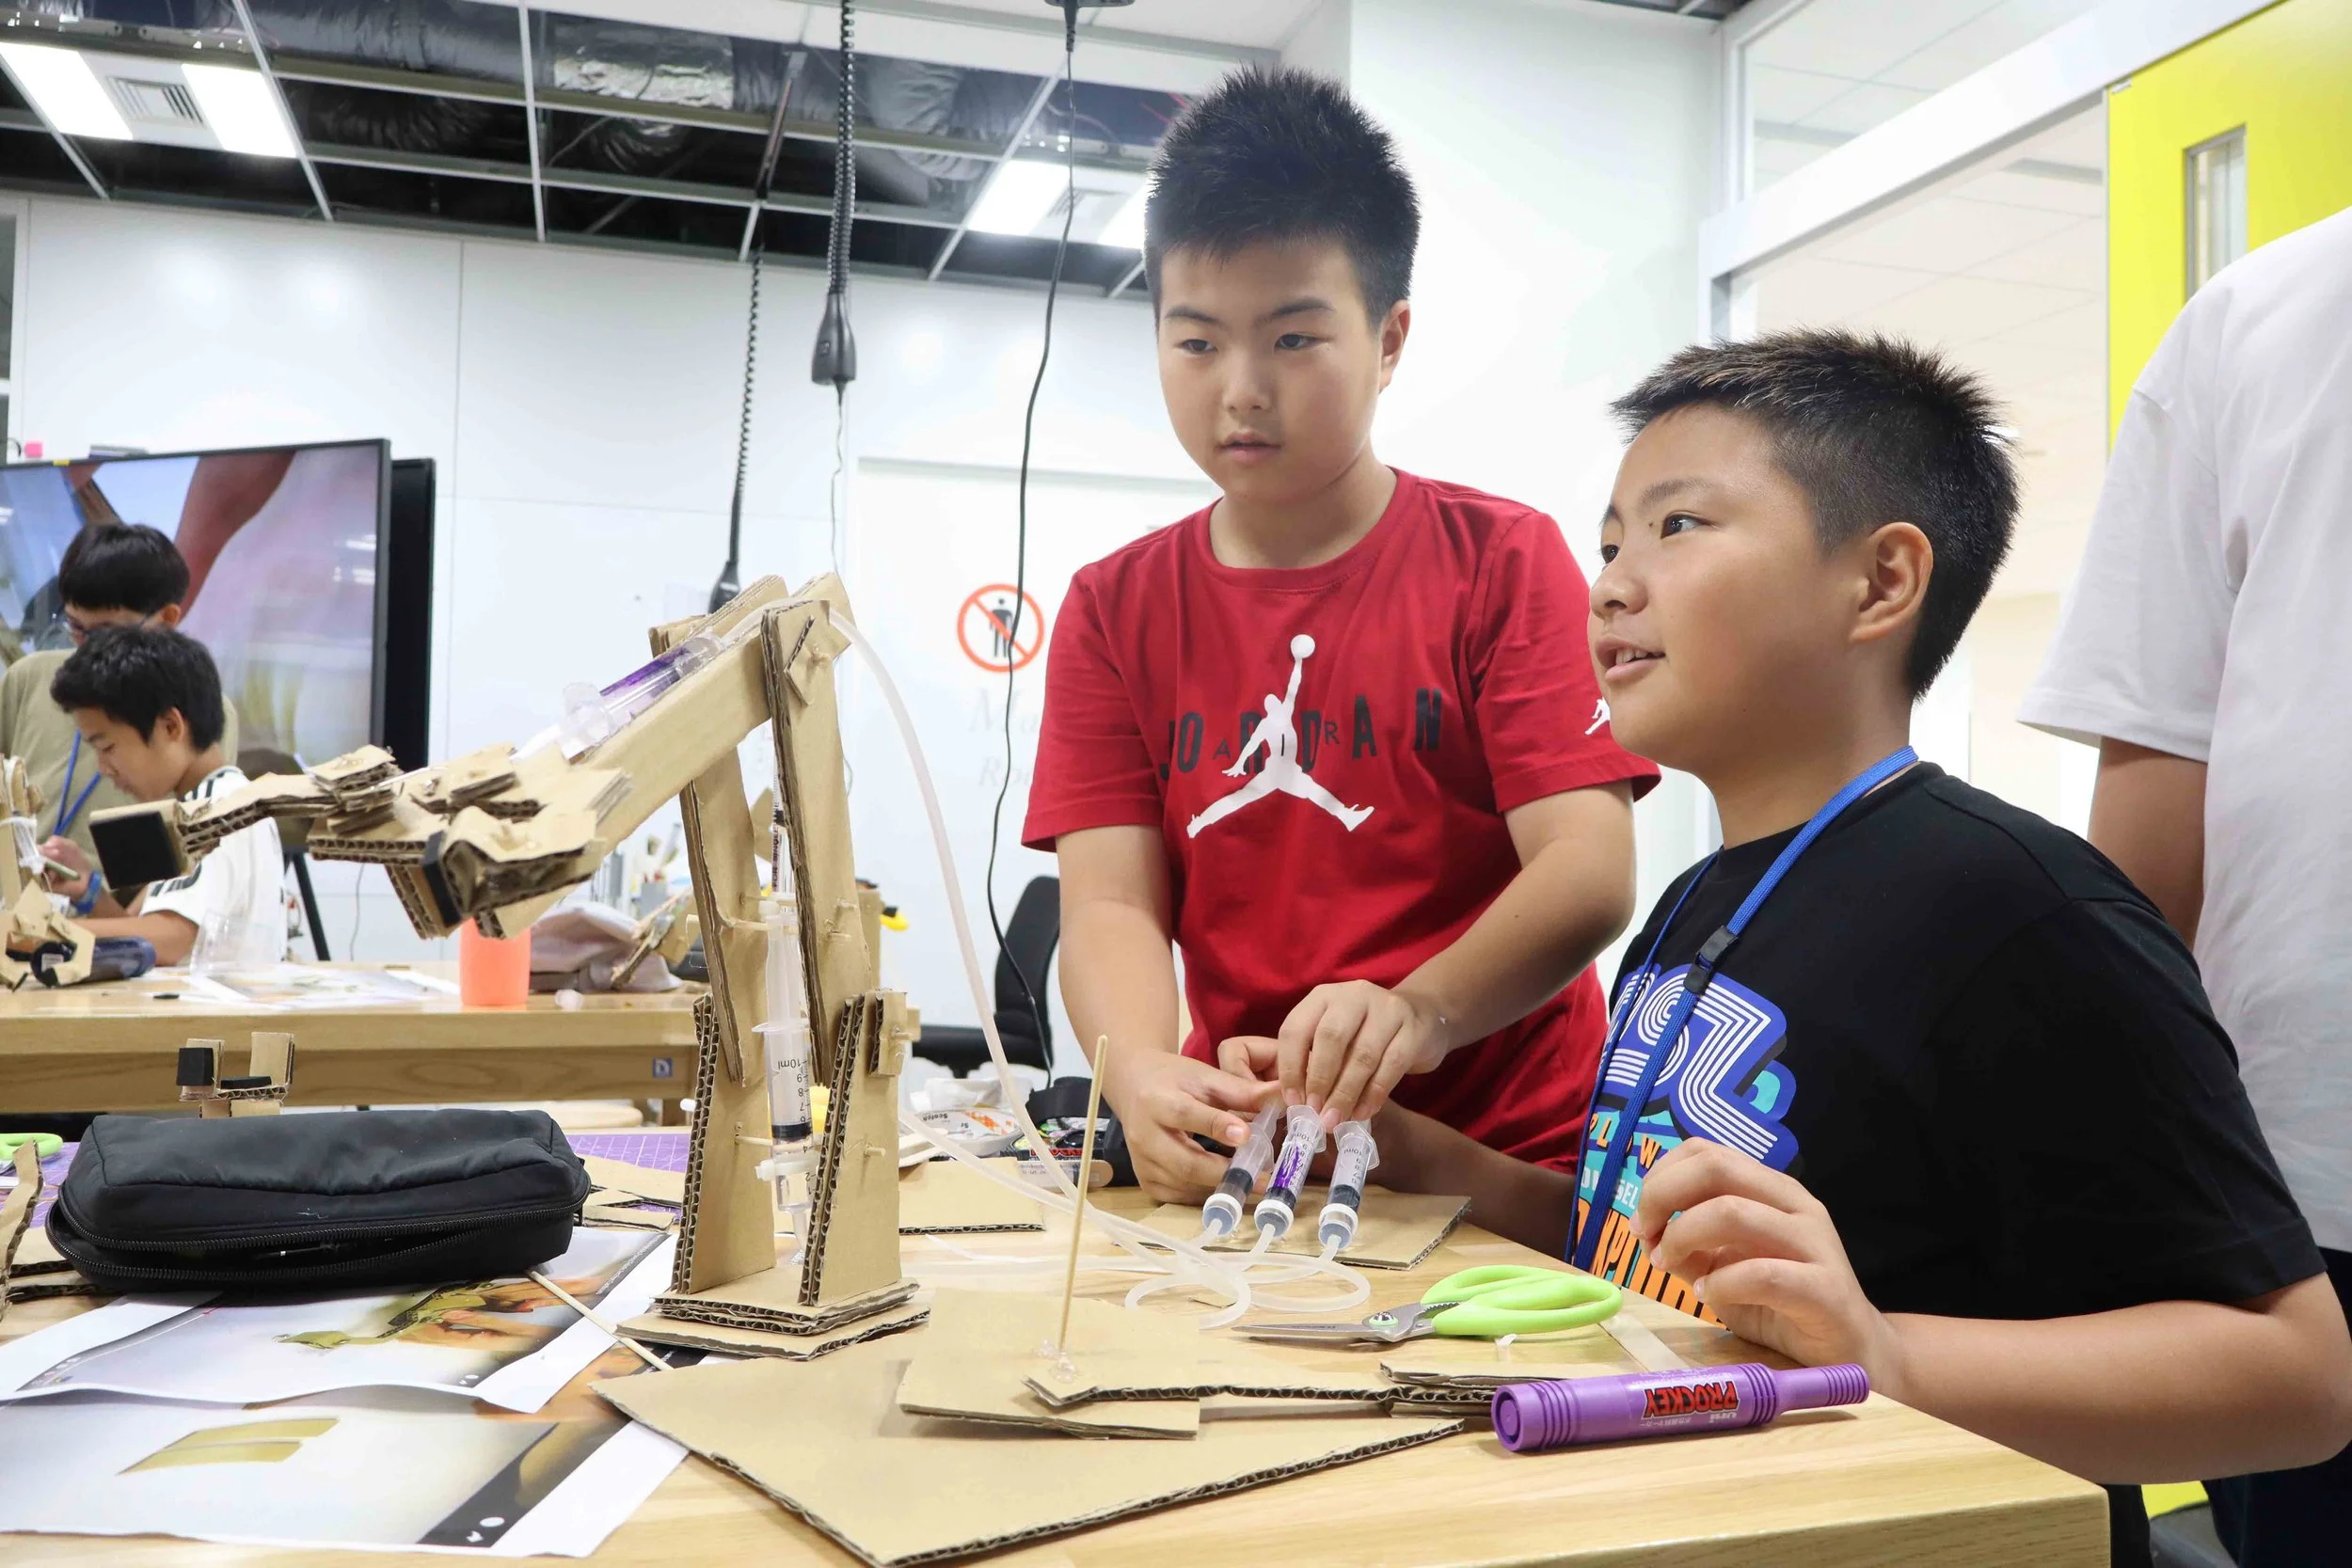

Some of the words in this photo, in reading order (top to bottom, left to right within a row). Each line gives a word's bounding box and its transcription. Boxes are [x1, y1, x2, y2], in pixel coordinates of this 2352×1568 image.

[778, 1059, 802, 1069] 10ml
[923, 1113, 948, 1121] Scotch
[1642, 1381, 1740, 1418] PROCKEY
